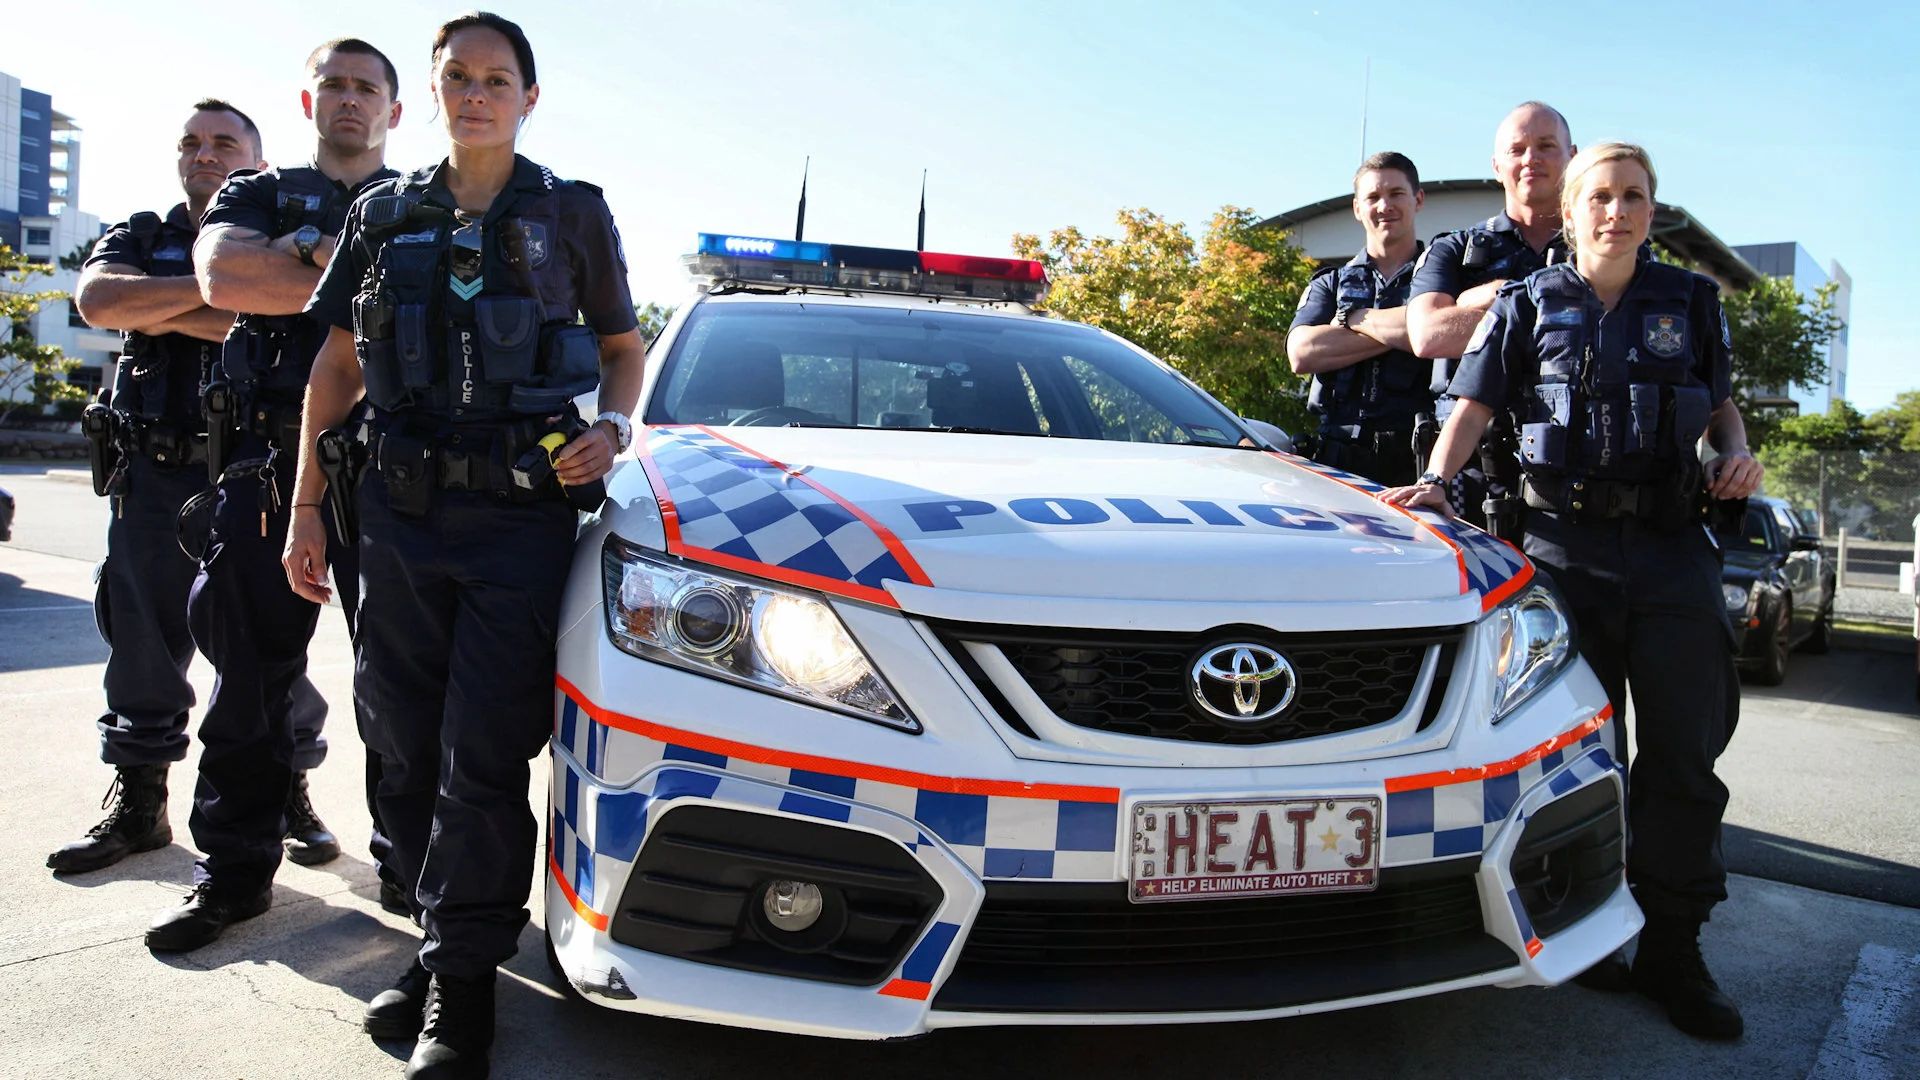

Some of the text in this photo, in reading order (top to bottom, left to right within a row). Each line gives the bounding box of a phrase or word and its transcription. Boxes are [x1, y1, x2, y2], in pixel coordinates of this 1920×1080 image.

[198, 345, 209, 397] POLICE
[461, 331, 474, 404] POLICE
[1600, 403, 1612, 466] POLICE
[902, 498, 1416, 541] POLICE
[1143, 813, 1157, 878] QLD
[1164, 807, 1374, 876] HEAT 3
[1161, 872, 1351, 894] HELP ELIMINATE AUTO THEFT
